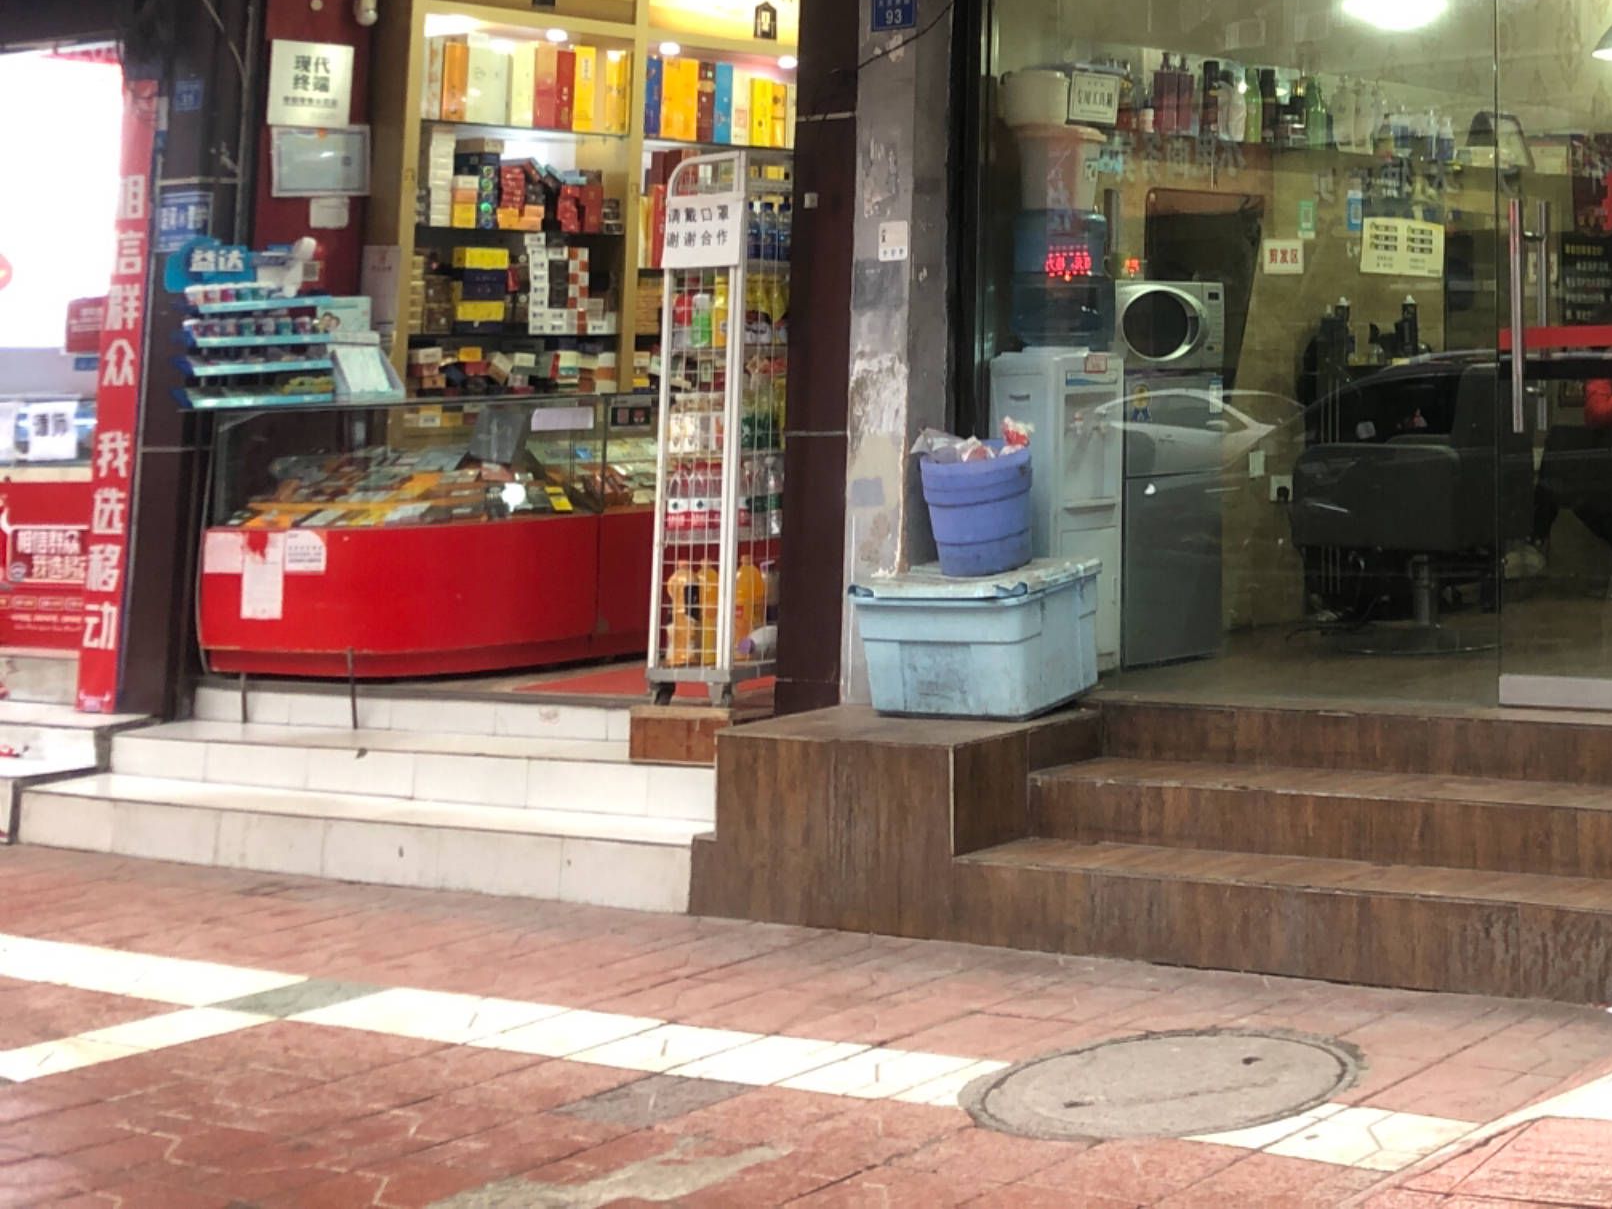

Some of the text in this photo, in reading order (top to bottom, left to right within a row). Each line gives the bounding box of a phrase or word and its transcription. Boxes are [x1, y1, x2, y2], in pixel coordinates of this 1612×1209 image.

[884, 9, 902, 24] 93
[668, 204, 729, 224] 请戴口罩
[666, 229, 728, 248] 谢谢合作
[189, 248, 245, 272] 益达
